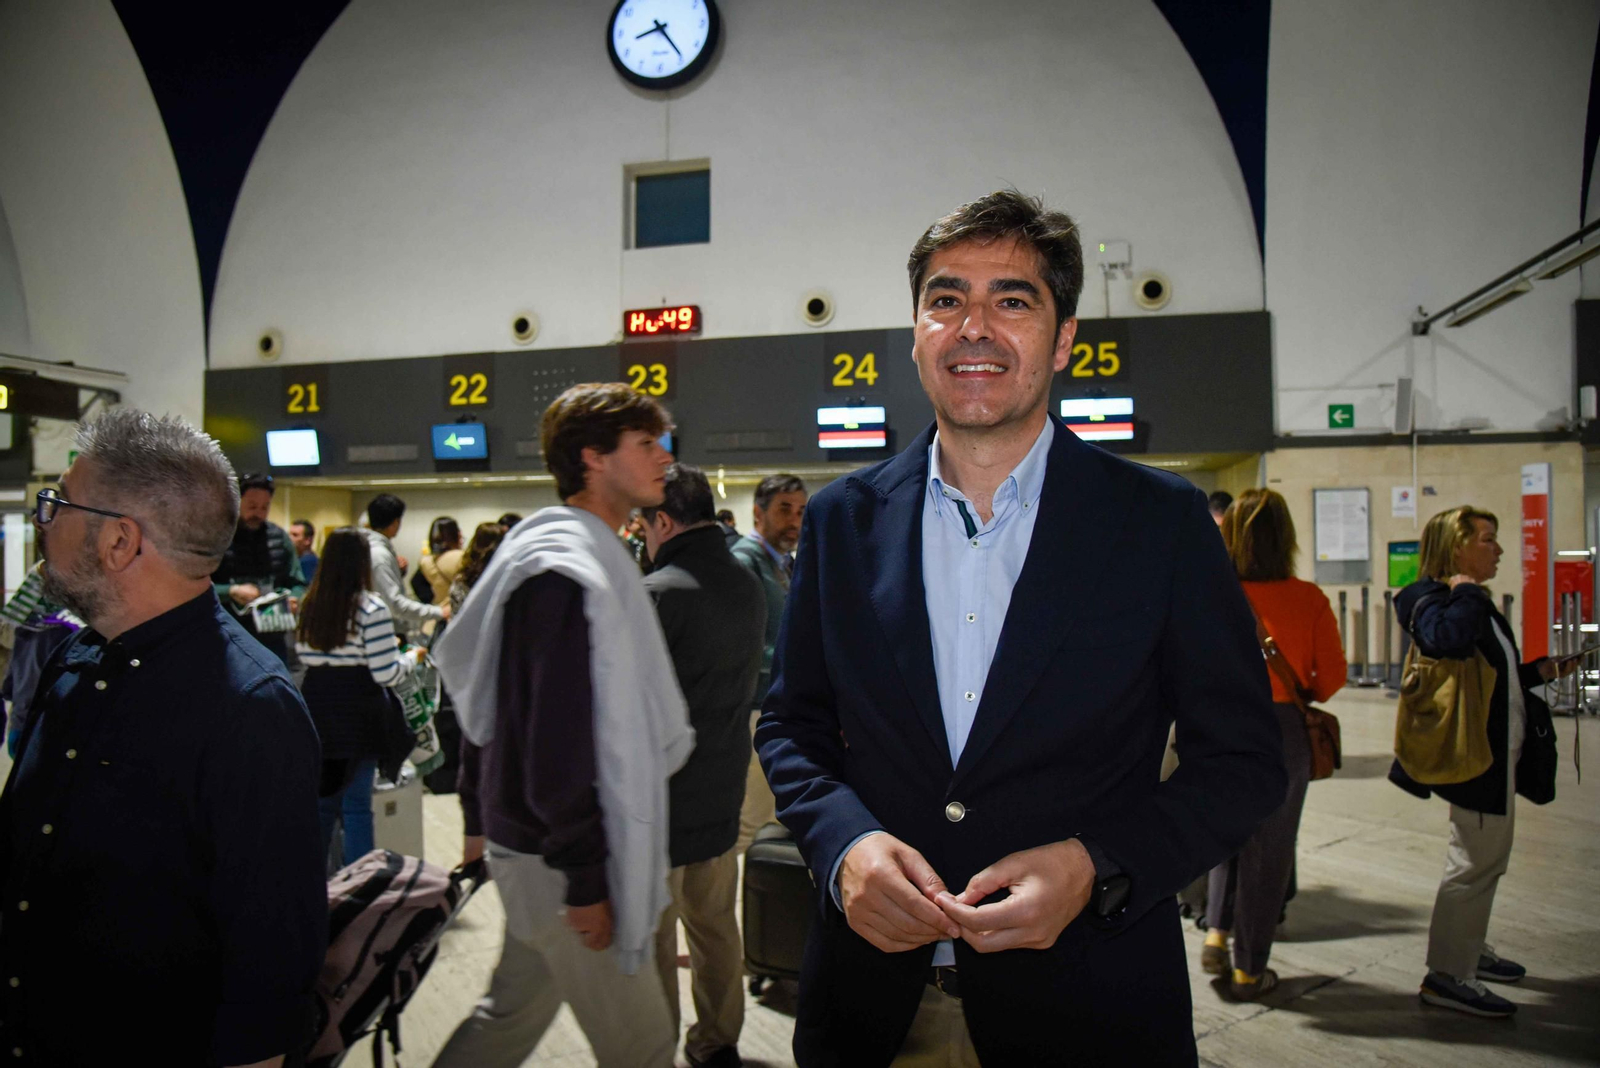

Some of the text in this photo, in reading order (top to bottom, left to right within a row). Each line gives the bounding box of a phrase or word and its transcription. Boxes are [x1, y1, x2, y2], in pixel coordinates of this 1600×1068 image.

[832, 352, 879, 386] 24
[1071, 341, 1120, 377] 25
[450, 373, 488, 405] 22
[627, 363, 668, 396] 23
[287, 383, 320, 413] 21
